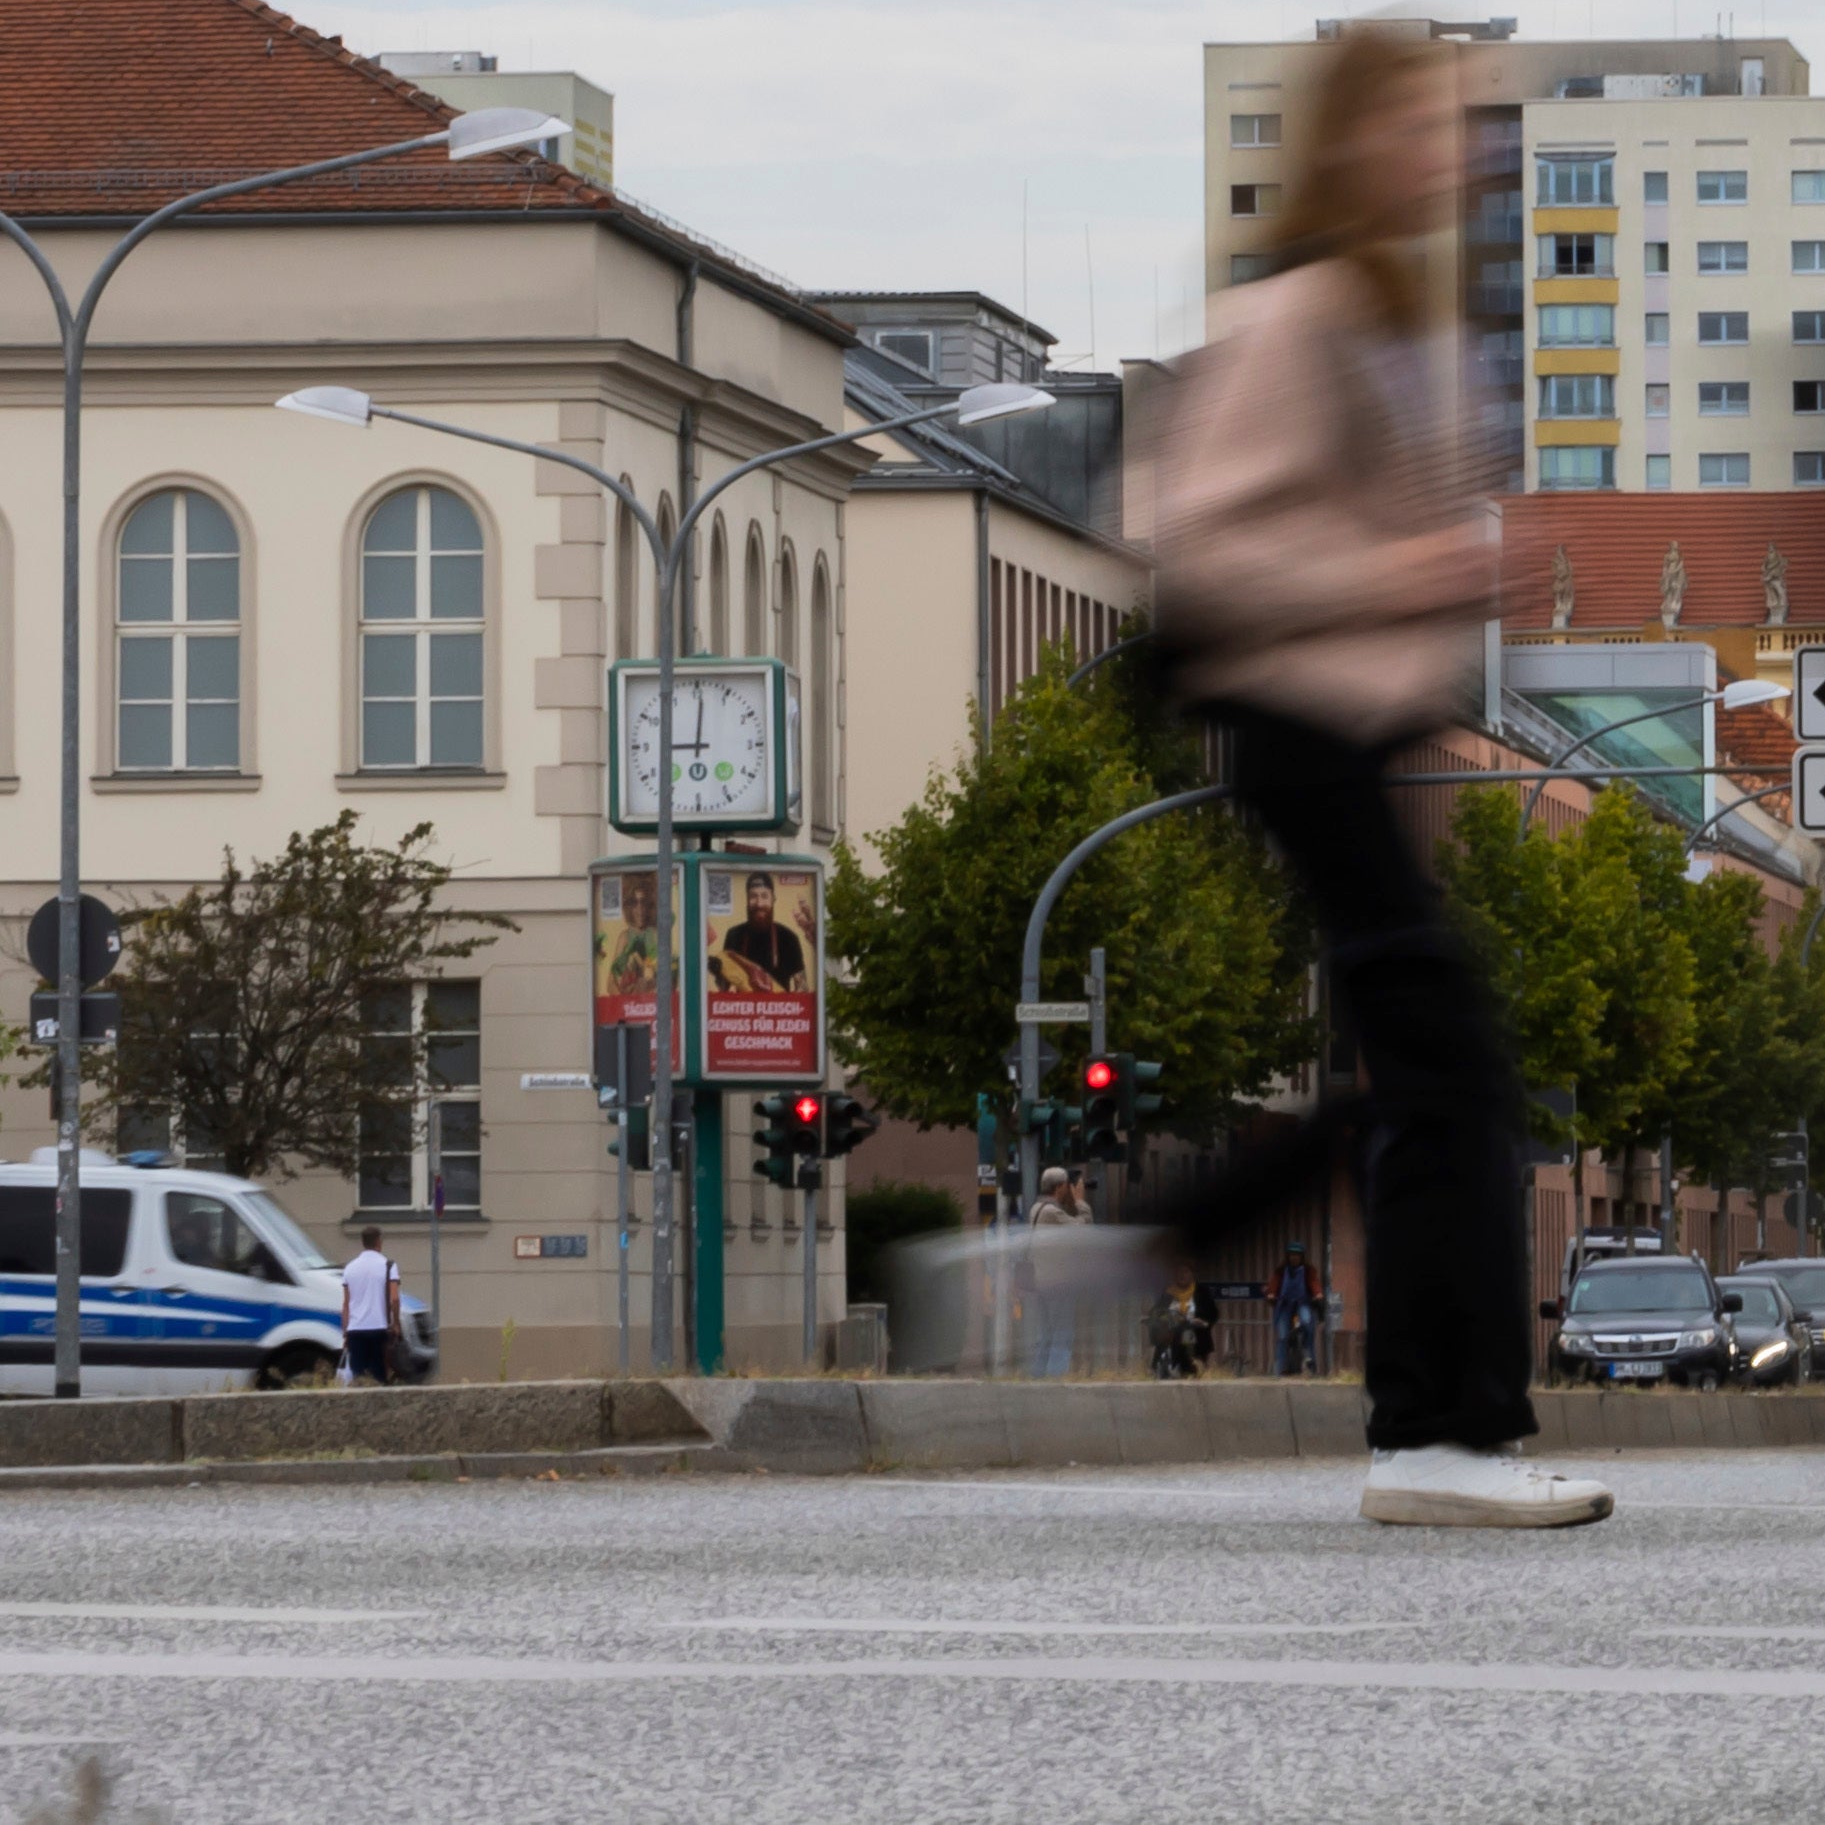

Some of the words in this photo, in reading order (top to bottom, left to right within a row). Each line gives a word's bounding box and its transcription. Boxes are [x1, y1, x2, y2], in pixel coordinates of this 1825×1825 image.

[712, 1001, 755, 1014] ECHTER
[756, 1001, 805, 1015] FLEISCH-
[708, 1018, 751, 1032] GENUSS
[752, 1015, 775, 1032] FÜR
[776, 1018, 810, 1032] JEDEN
[724, 1035, 793, 1050] GESCHMACK
